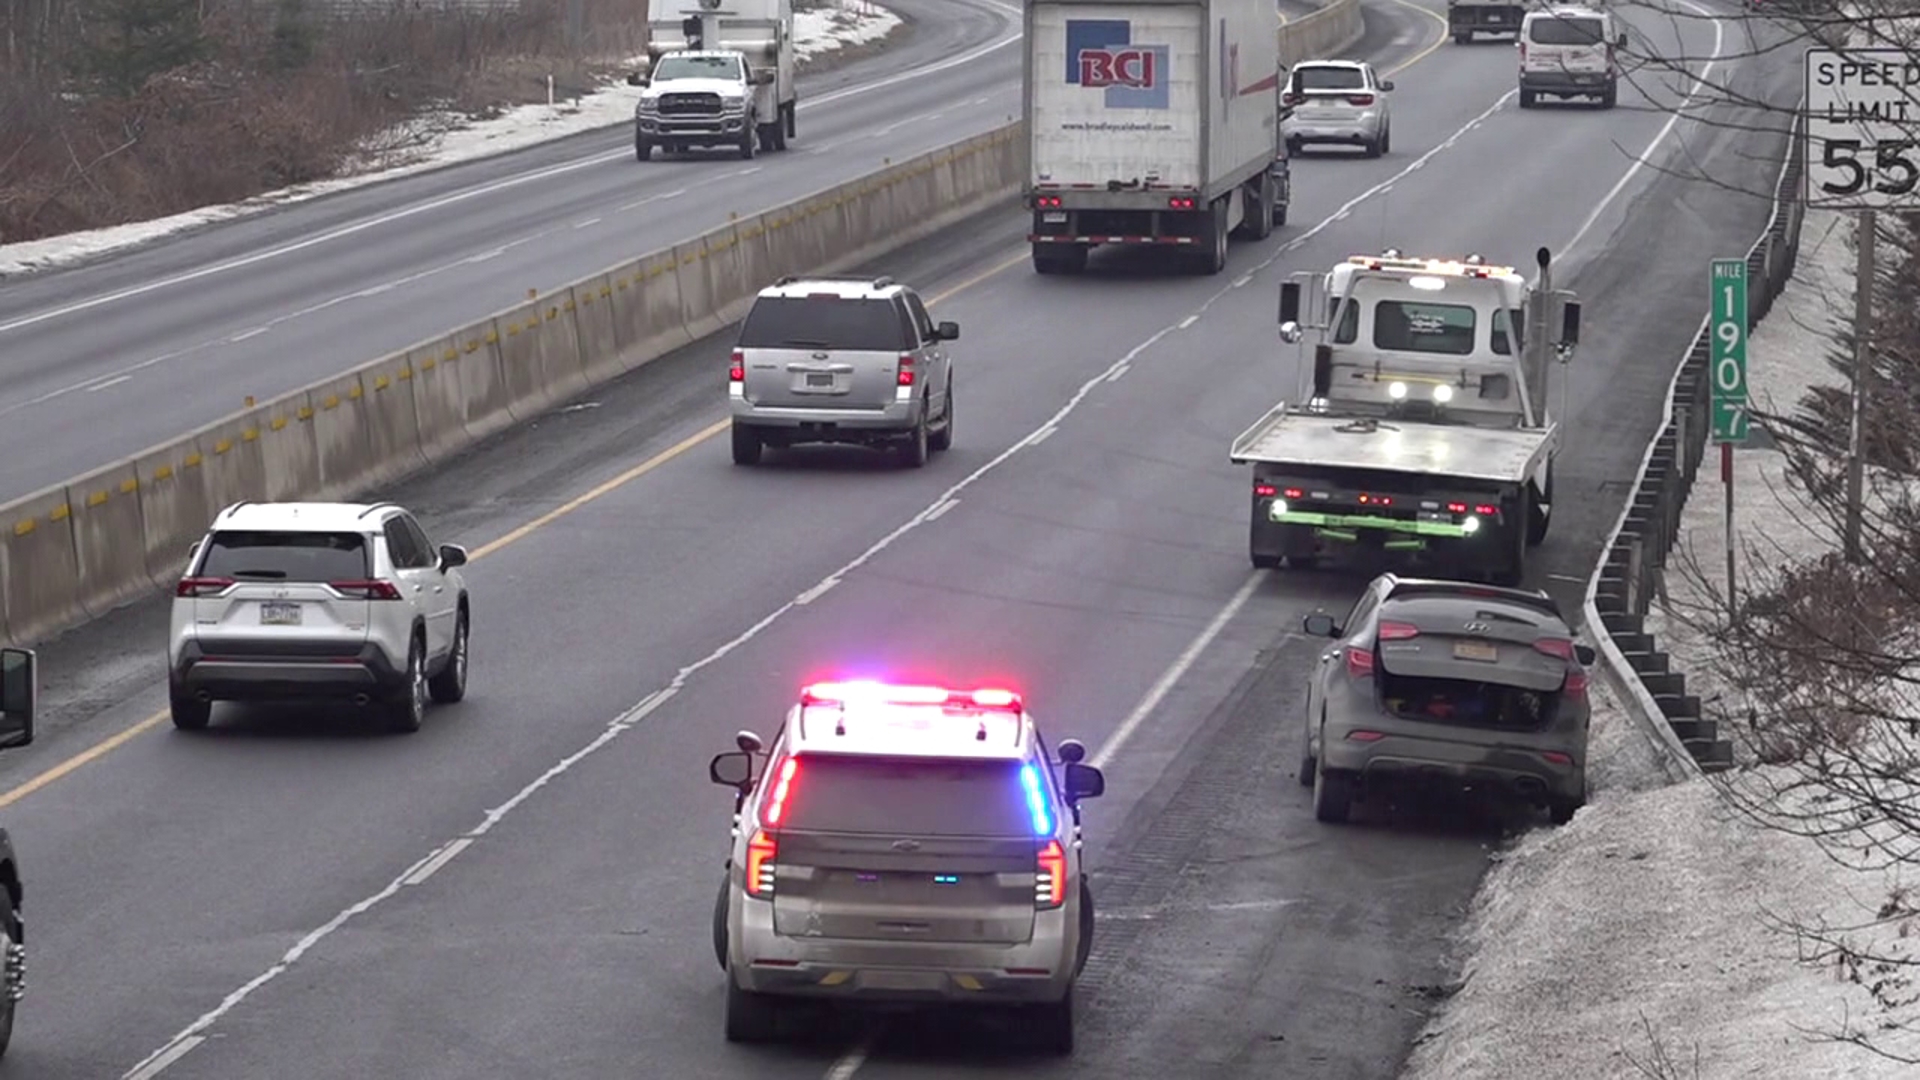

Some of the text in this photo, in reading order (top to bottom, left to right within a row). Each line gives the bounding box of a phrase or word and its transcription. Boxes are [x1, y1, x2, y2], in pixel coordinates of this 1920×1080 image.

[1080, 50, 1153, 88] BCI
[1817, 63, 1920, 86] SPEED
[1829, 101, 1909, 124] LIMIT
[1822, 140, 1919, 195] 55
[1715, 264, 1741, 278] MILE
